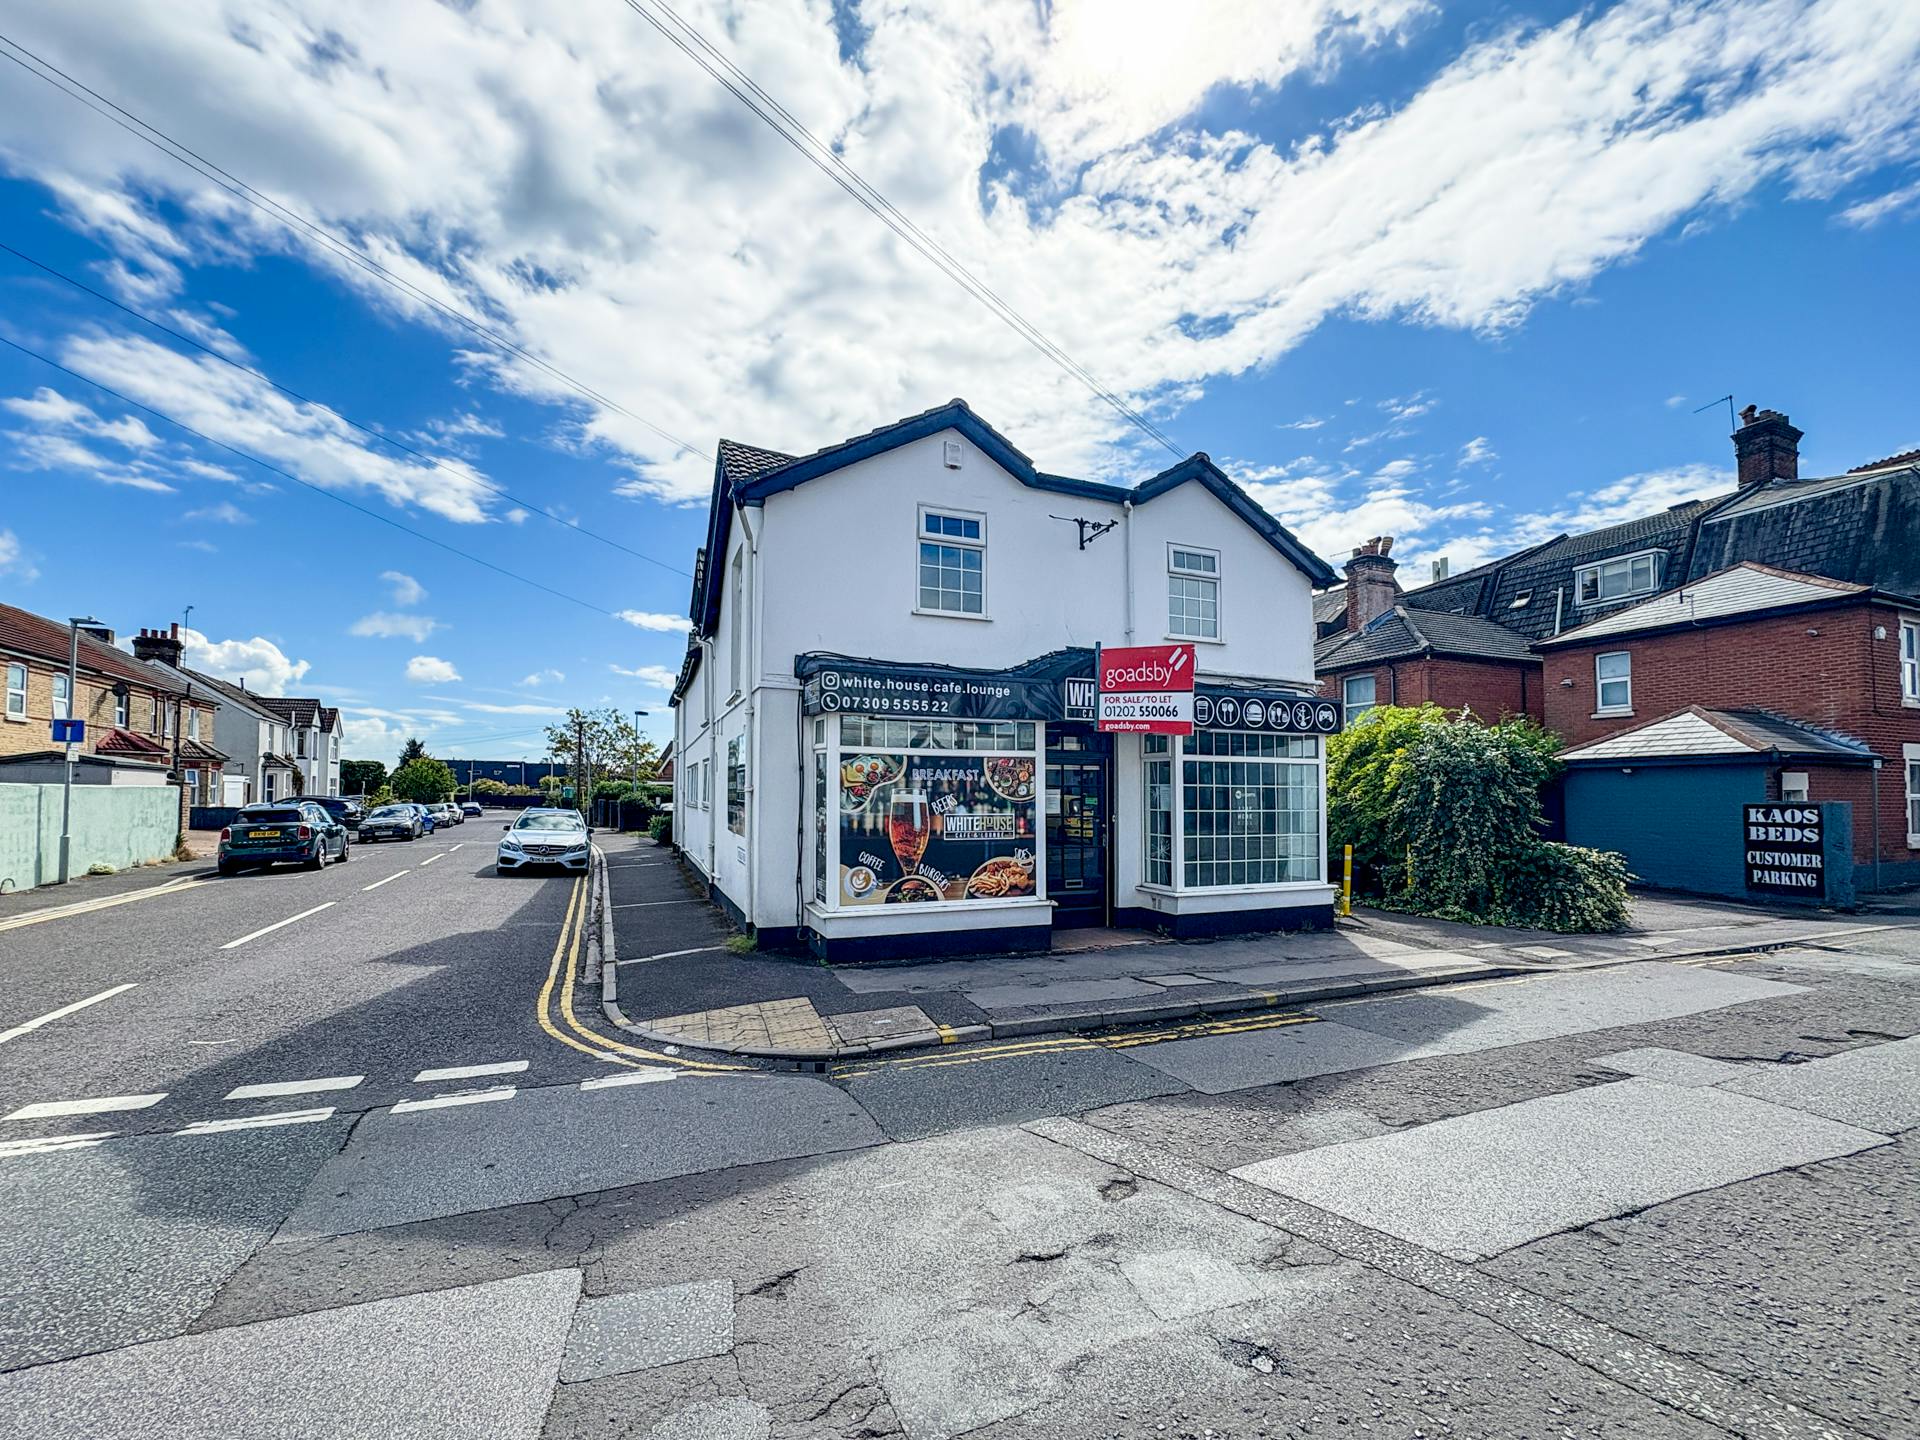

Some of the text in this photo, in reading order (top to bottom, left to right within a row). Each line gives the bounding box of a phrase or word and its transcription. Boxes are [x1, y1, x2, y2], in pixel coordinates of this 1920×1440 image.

[1105, 660, 1173, 688] goadsby
[842, 677, 1010, 698] white.house.cafe.lounge
[1104, 696, 1121, 704] FOR
[1159, 696, 1173, 704] LET
[1104, 705, 1179, 717] 01202 550066
[1105, 721, 1151, 731] goadsby.com
[912, 768, 980, 781] BREAKFAST
[931, 793, 958, 815] BEERS
[1748, 808, 1820, 824] KAOS
[1748, 826, 1820, 843] BEDS
[858, 850, 886, 871] COFFEE
[1746, 850, 1823, 868] CUSTOMER
[918, 863, 951, 892] BURGERS
[1752, 869, 1817, 887] PARKING
